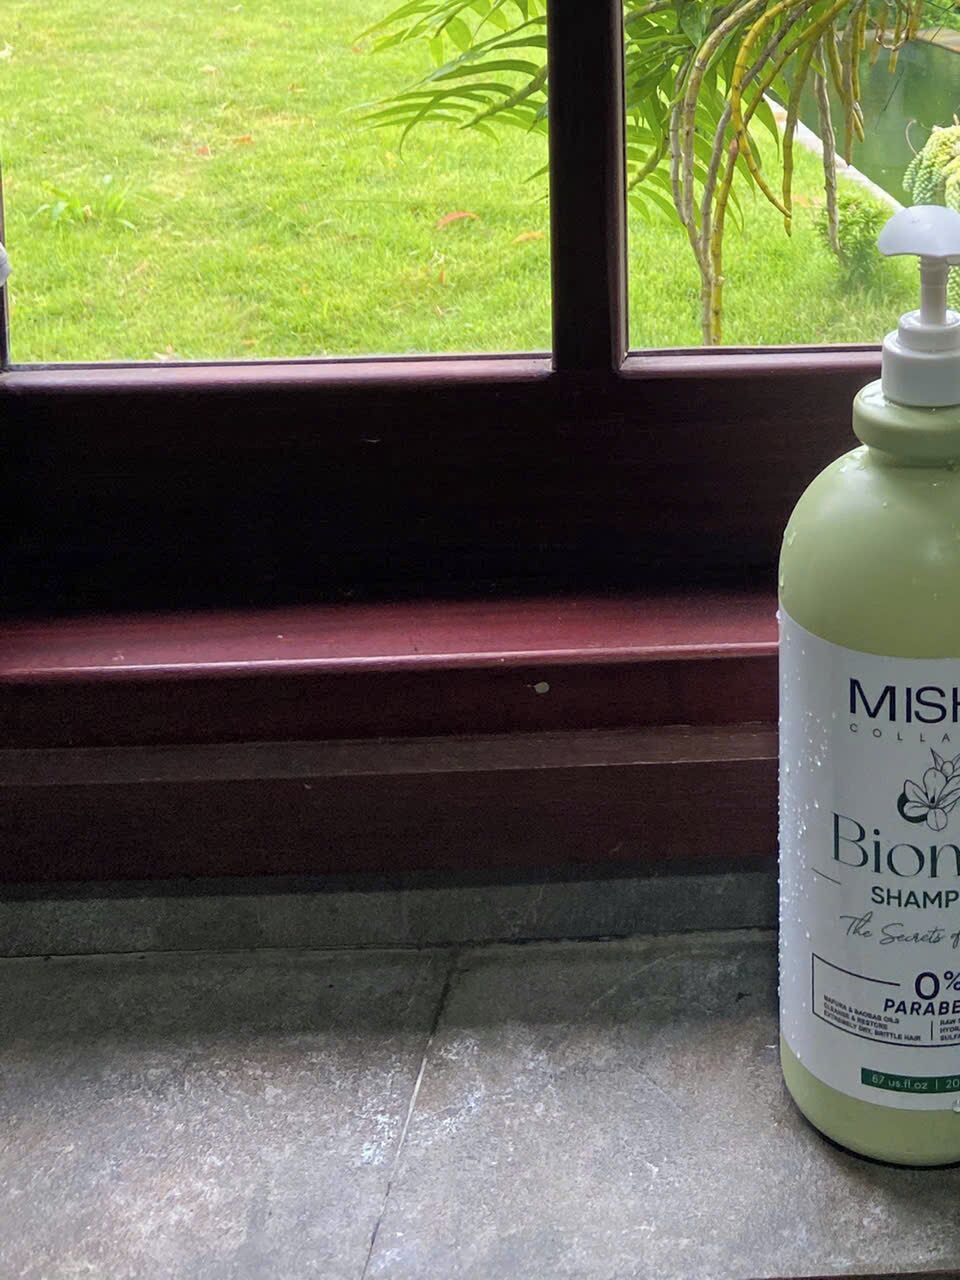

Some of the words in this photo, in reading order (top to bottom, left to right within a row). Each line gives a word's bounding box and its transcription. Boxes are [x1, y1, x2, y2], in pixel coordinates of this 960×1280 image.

[839, 911, 874, 939] The
[879, 922, 944, 945] Secrets
[940, 1018, 956, 1026] RAW
[874, 1030, 903, 1040] BRITTLE
[904, 1034, 921, 1042] HAIR
[871, 1074, 885, 1084] 67
